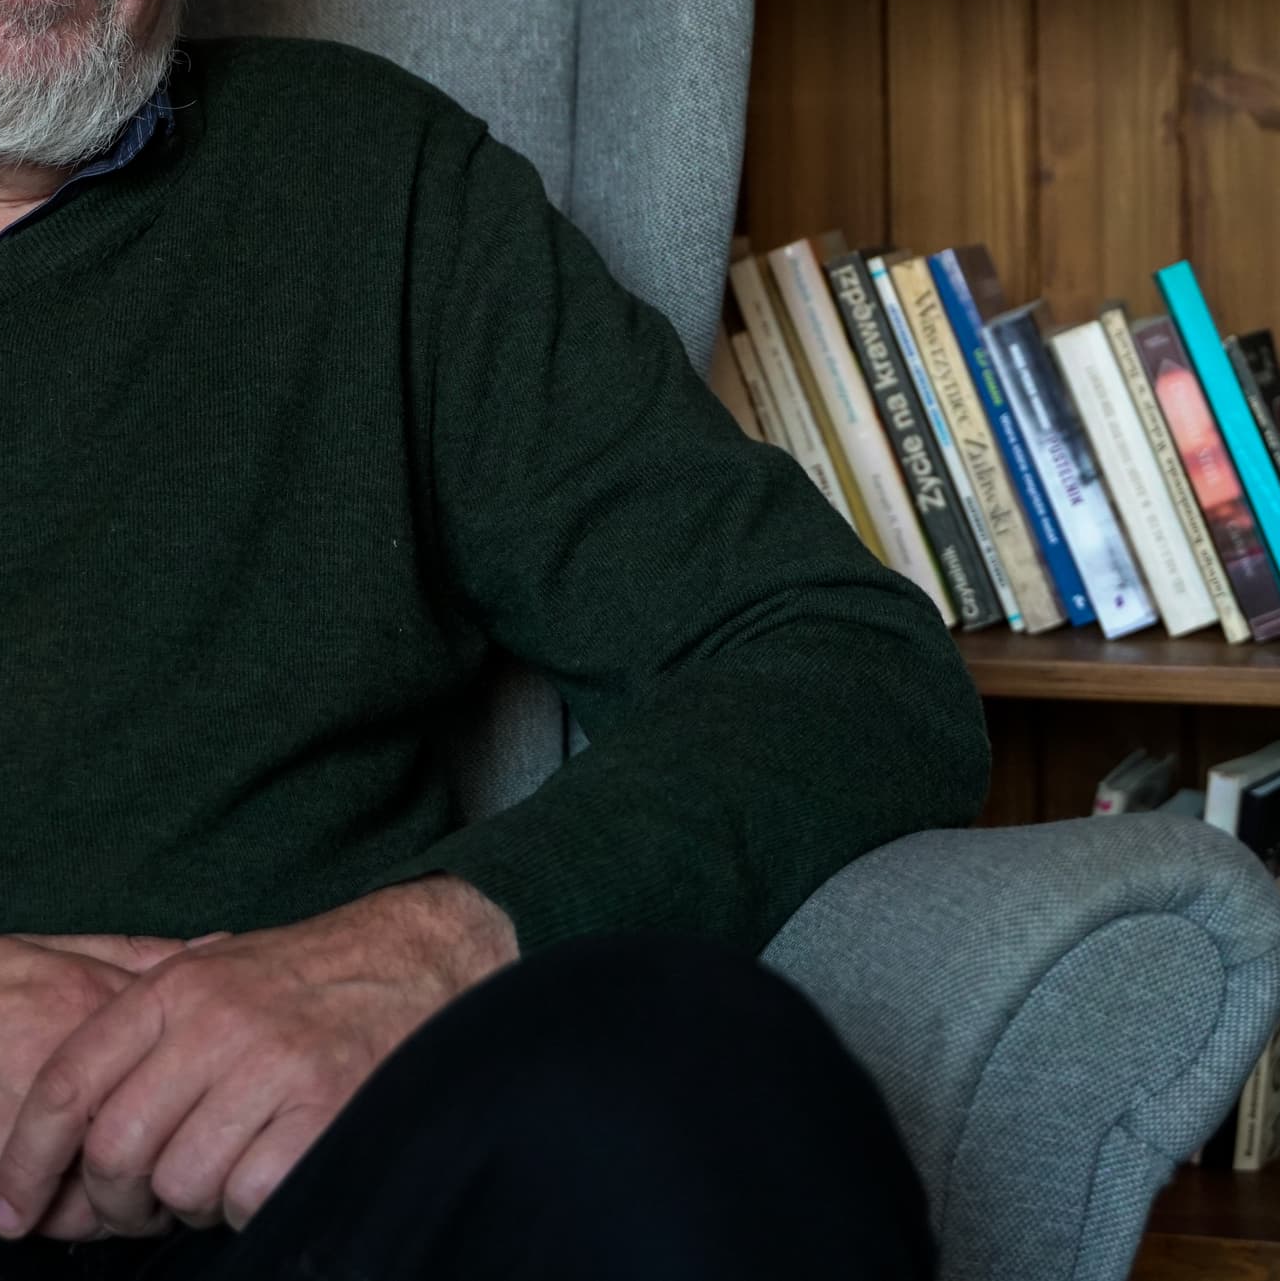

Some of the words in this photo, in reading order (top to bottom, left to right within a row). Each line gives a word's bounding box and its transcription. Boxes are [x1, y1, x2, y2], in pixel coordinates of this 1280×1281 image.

[828, 260, 904, 392] krawędzi
[903, 288, 977, 427] Wawrzyniec
[883, 390, 915, 432] na
[894, 430, 951, 515] Życie
[1041, 433, 1085, 507] PUSTELNIK
[938, 543, 982, 620] Czytelnik
[1195, 547, 1226, 600] Jadwiga
